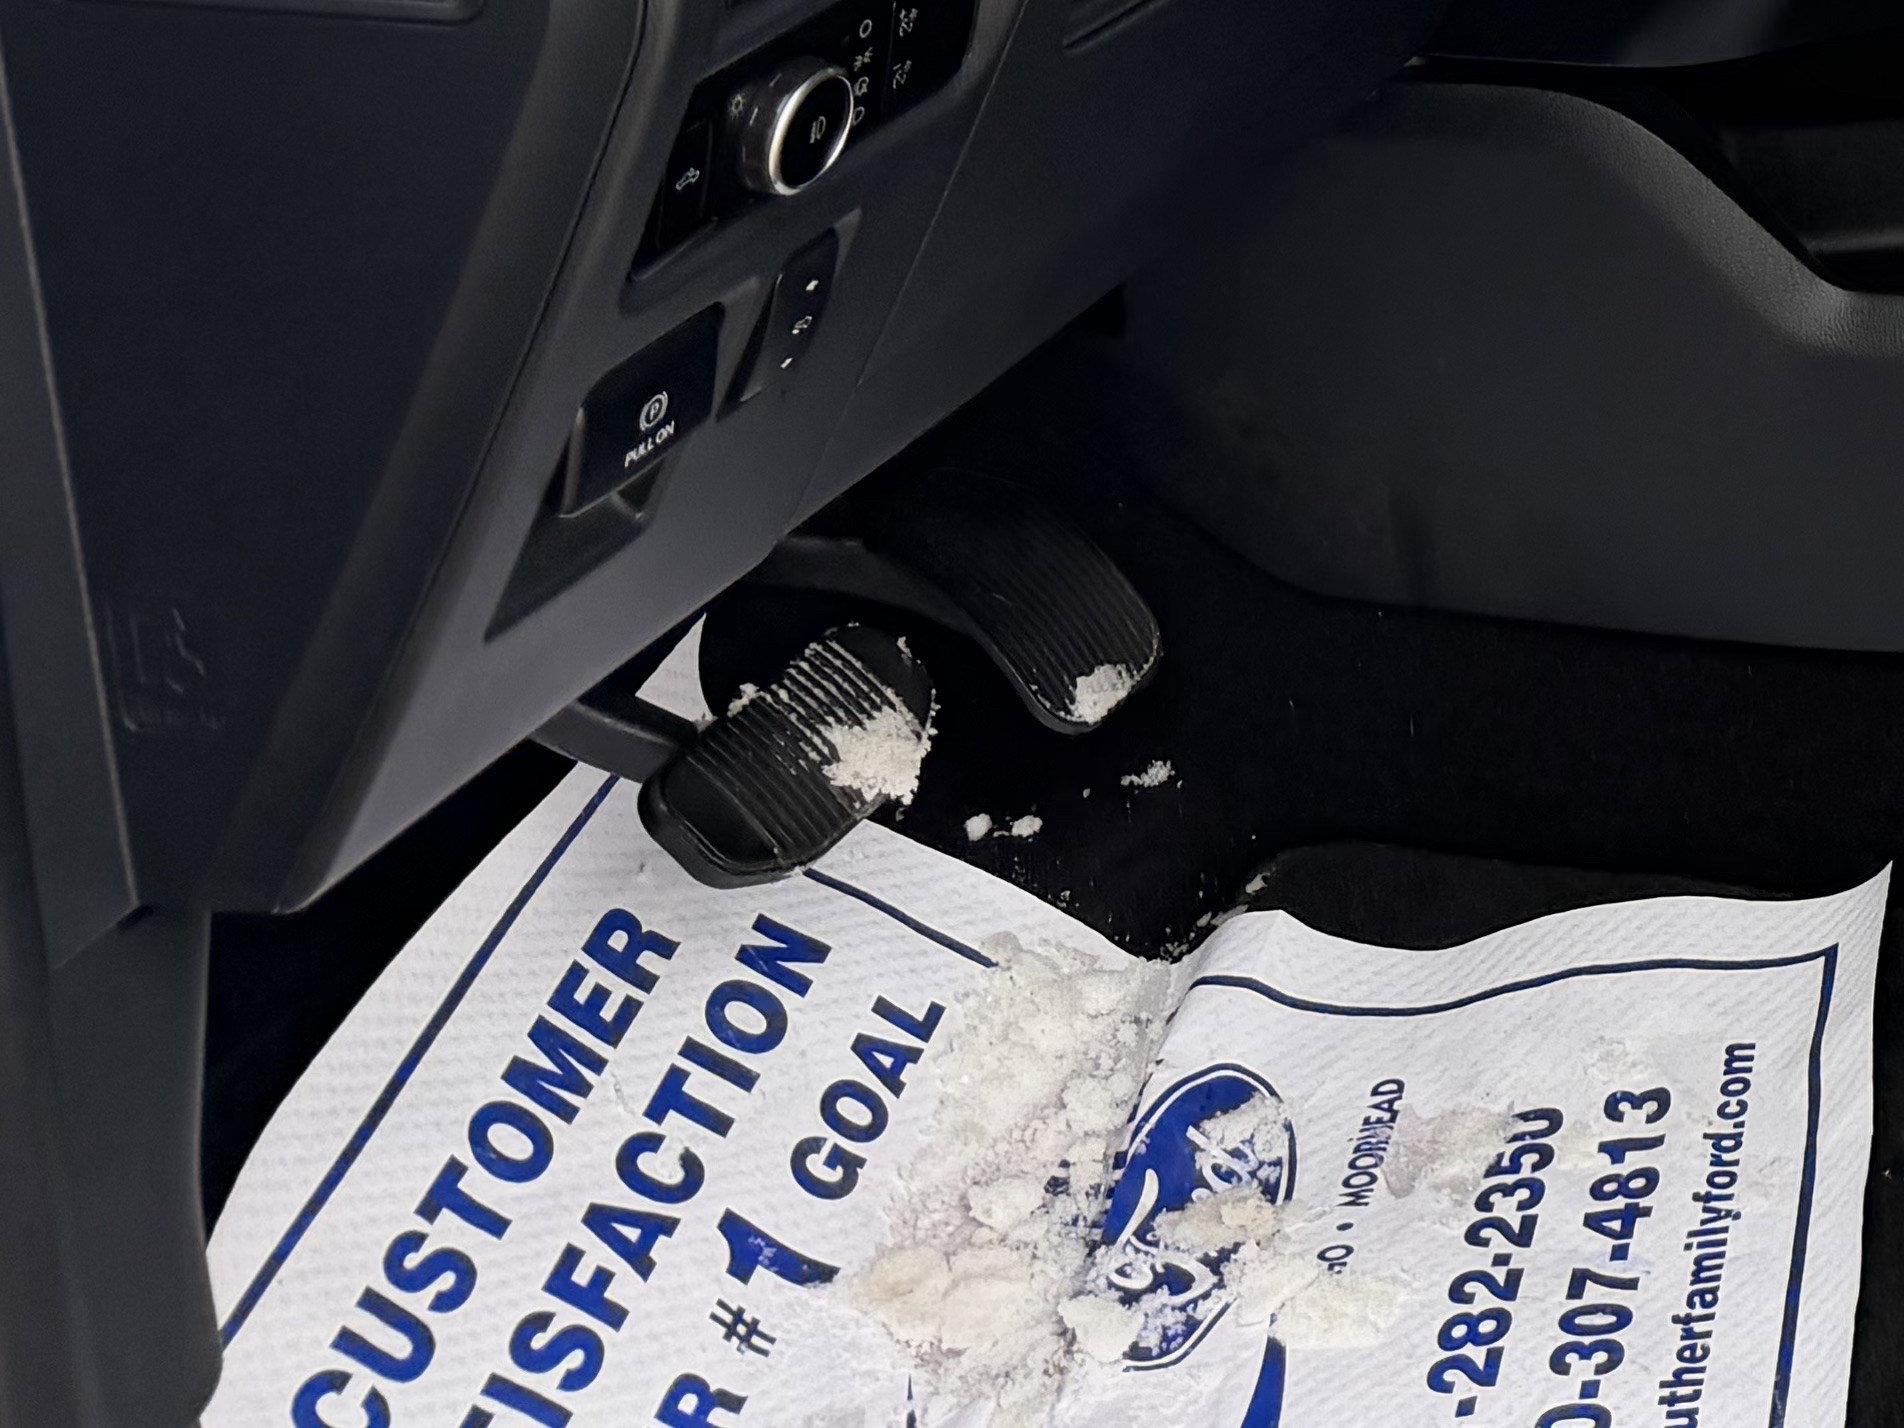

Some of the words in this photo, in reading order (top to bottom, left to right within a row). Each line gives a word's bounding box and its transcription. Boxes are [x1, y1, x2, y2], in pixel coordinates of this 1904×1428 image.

[655, 418, 676, 445] ON
[290, 907, 681, 1428] CUSTOMER
[789, 994, 947, 1200] GOAL
[1657, 1041, 1757, 1428] utherfamilyford.com
